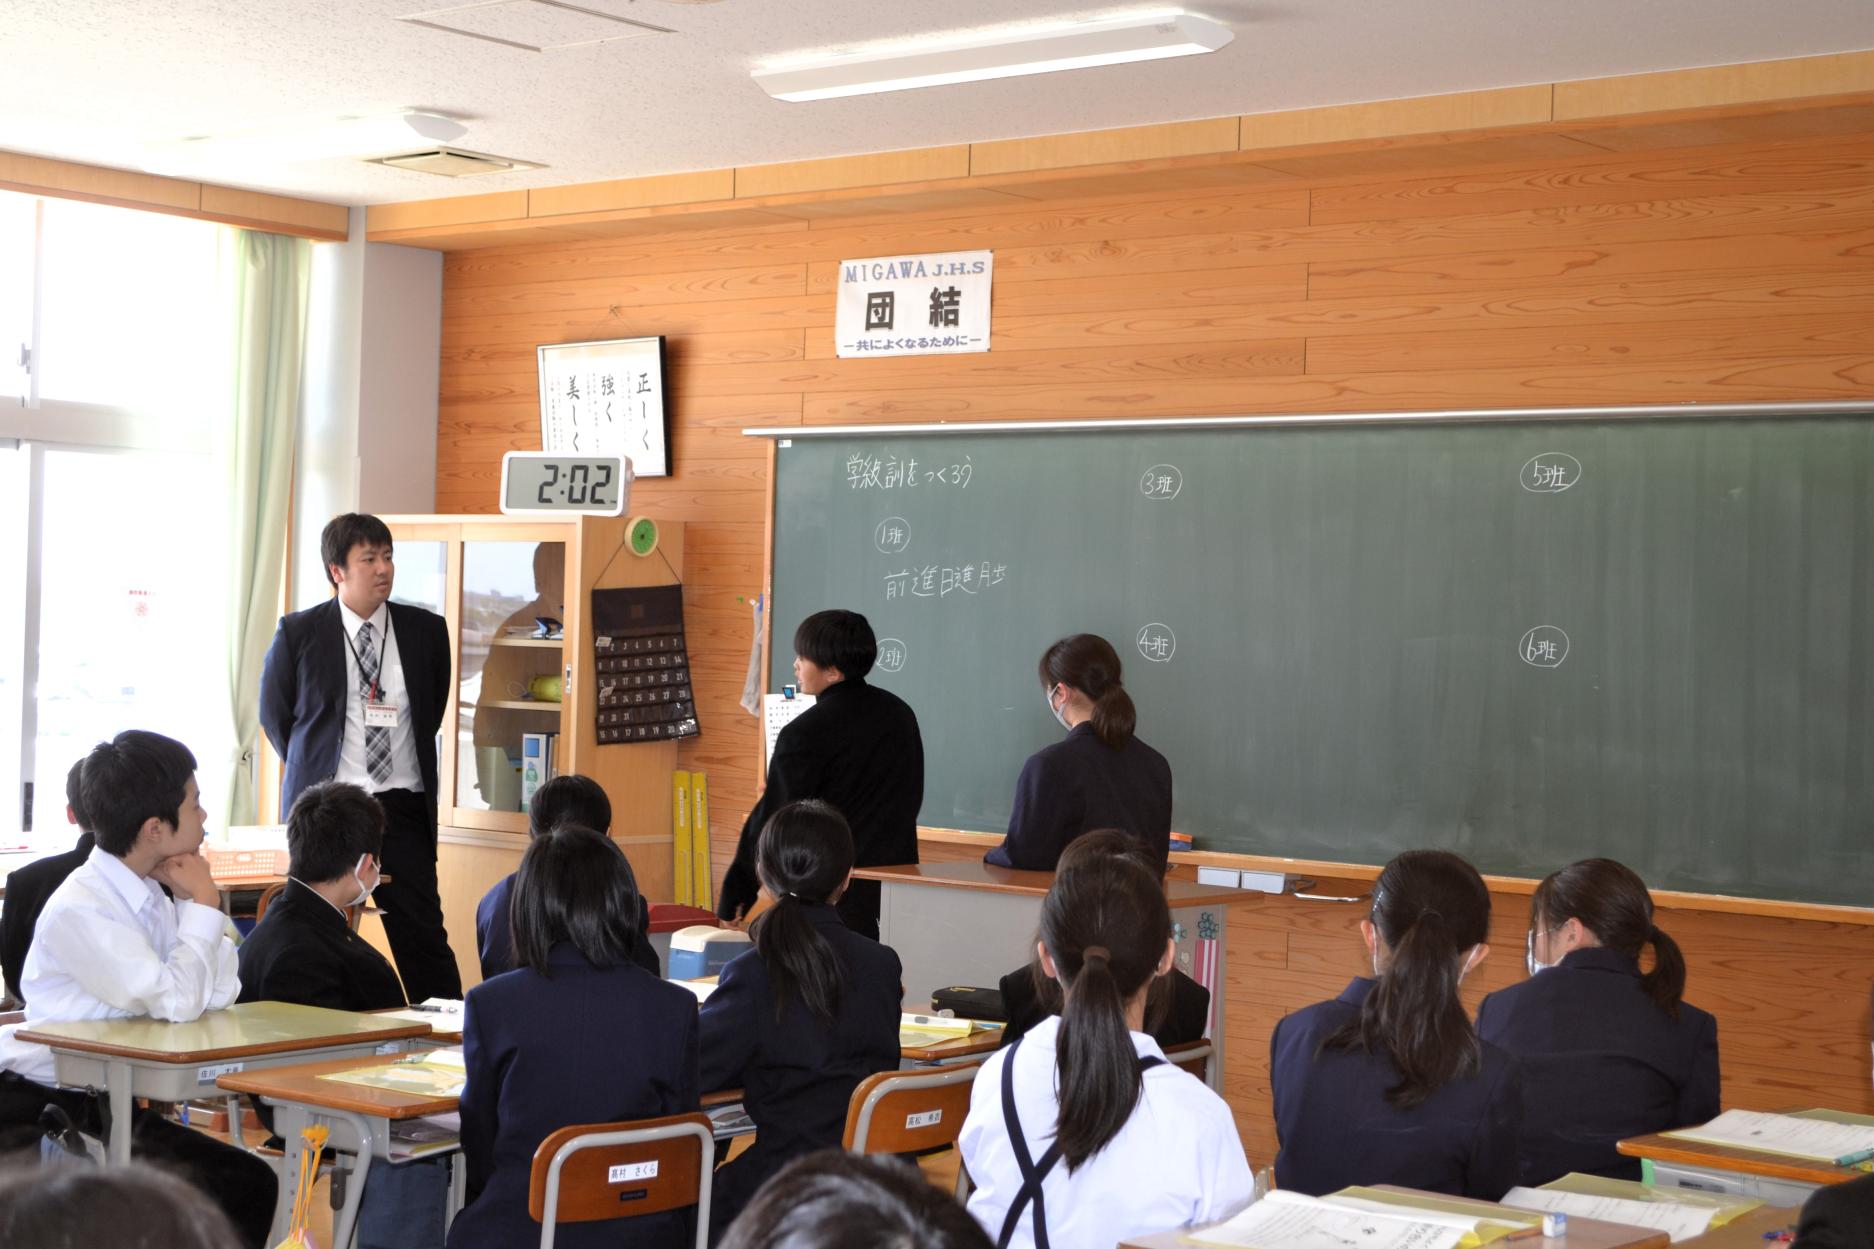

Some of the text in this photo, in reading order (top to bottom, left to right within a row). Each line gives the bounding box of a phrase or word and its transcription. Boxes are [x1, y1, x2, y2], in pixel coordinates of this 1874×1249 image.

[932, 261, 985, 277] J.H.S
[566, 375, 580, 452] 美しく
[601, 373, 615, 423] 強く
[636, 372, 652, 451] 正しく
[537, 464, 612, 505] 2:02
